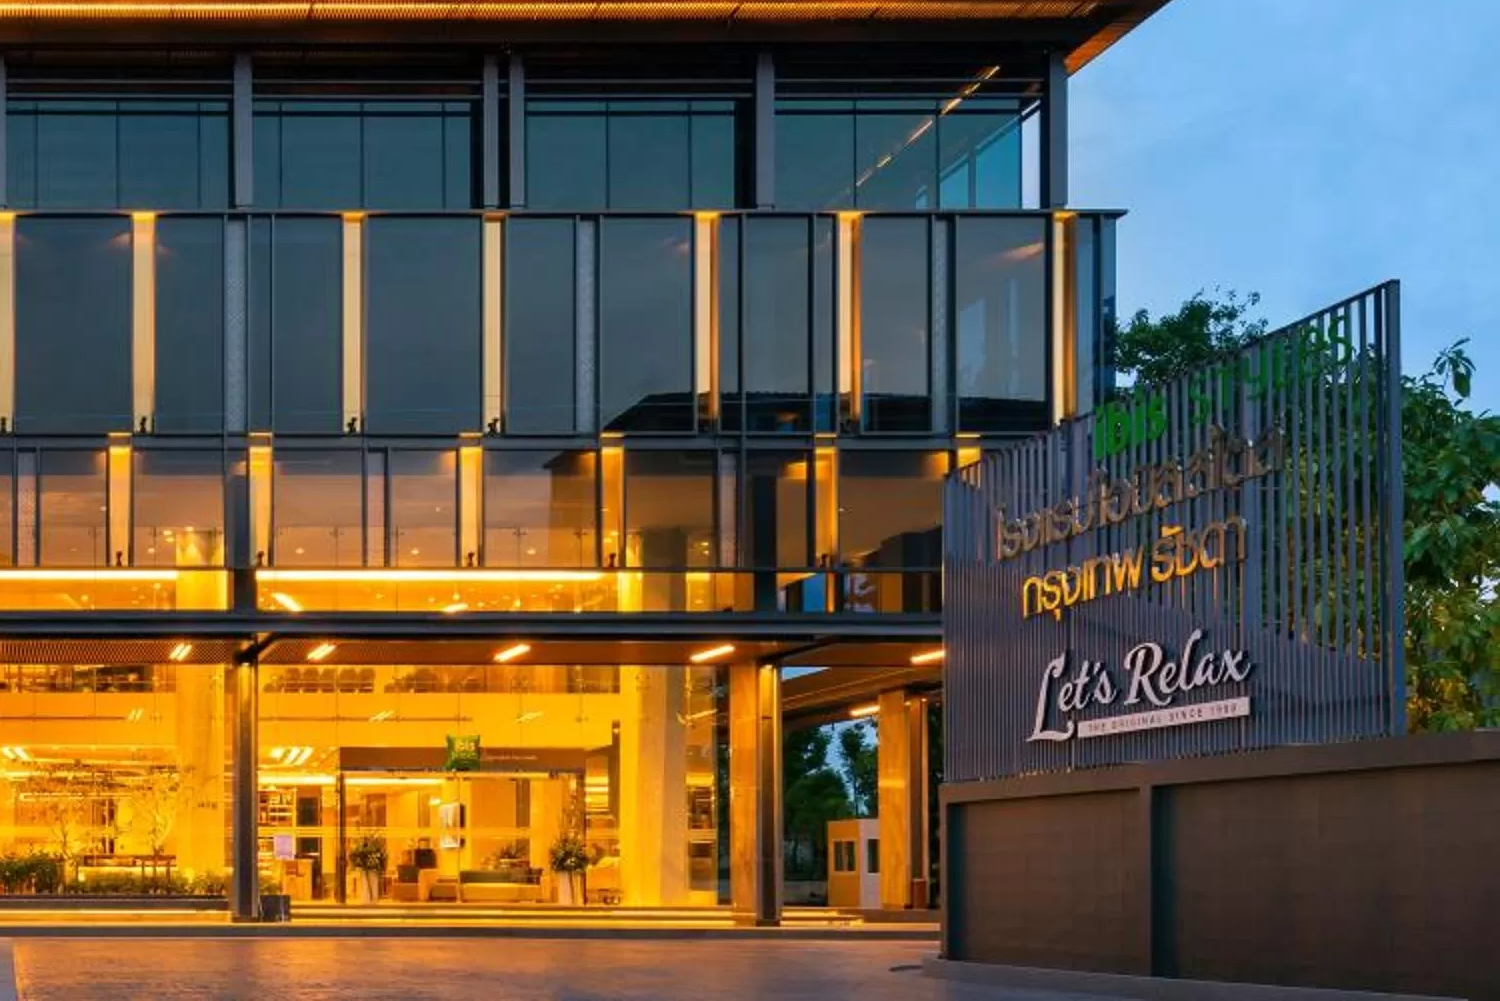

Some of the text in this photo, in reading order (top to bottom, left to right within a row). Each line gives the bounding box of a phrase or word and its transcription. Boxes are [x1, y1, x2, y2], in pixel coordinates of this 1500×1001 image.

[1095, 383, 1166, 459] ibis
[1026, 628, 1250, 742] Let's Relax
